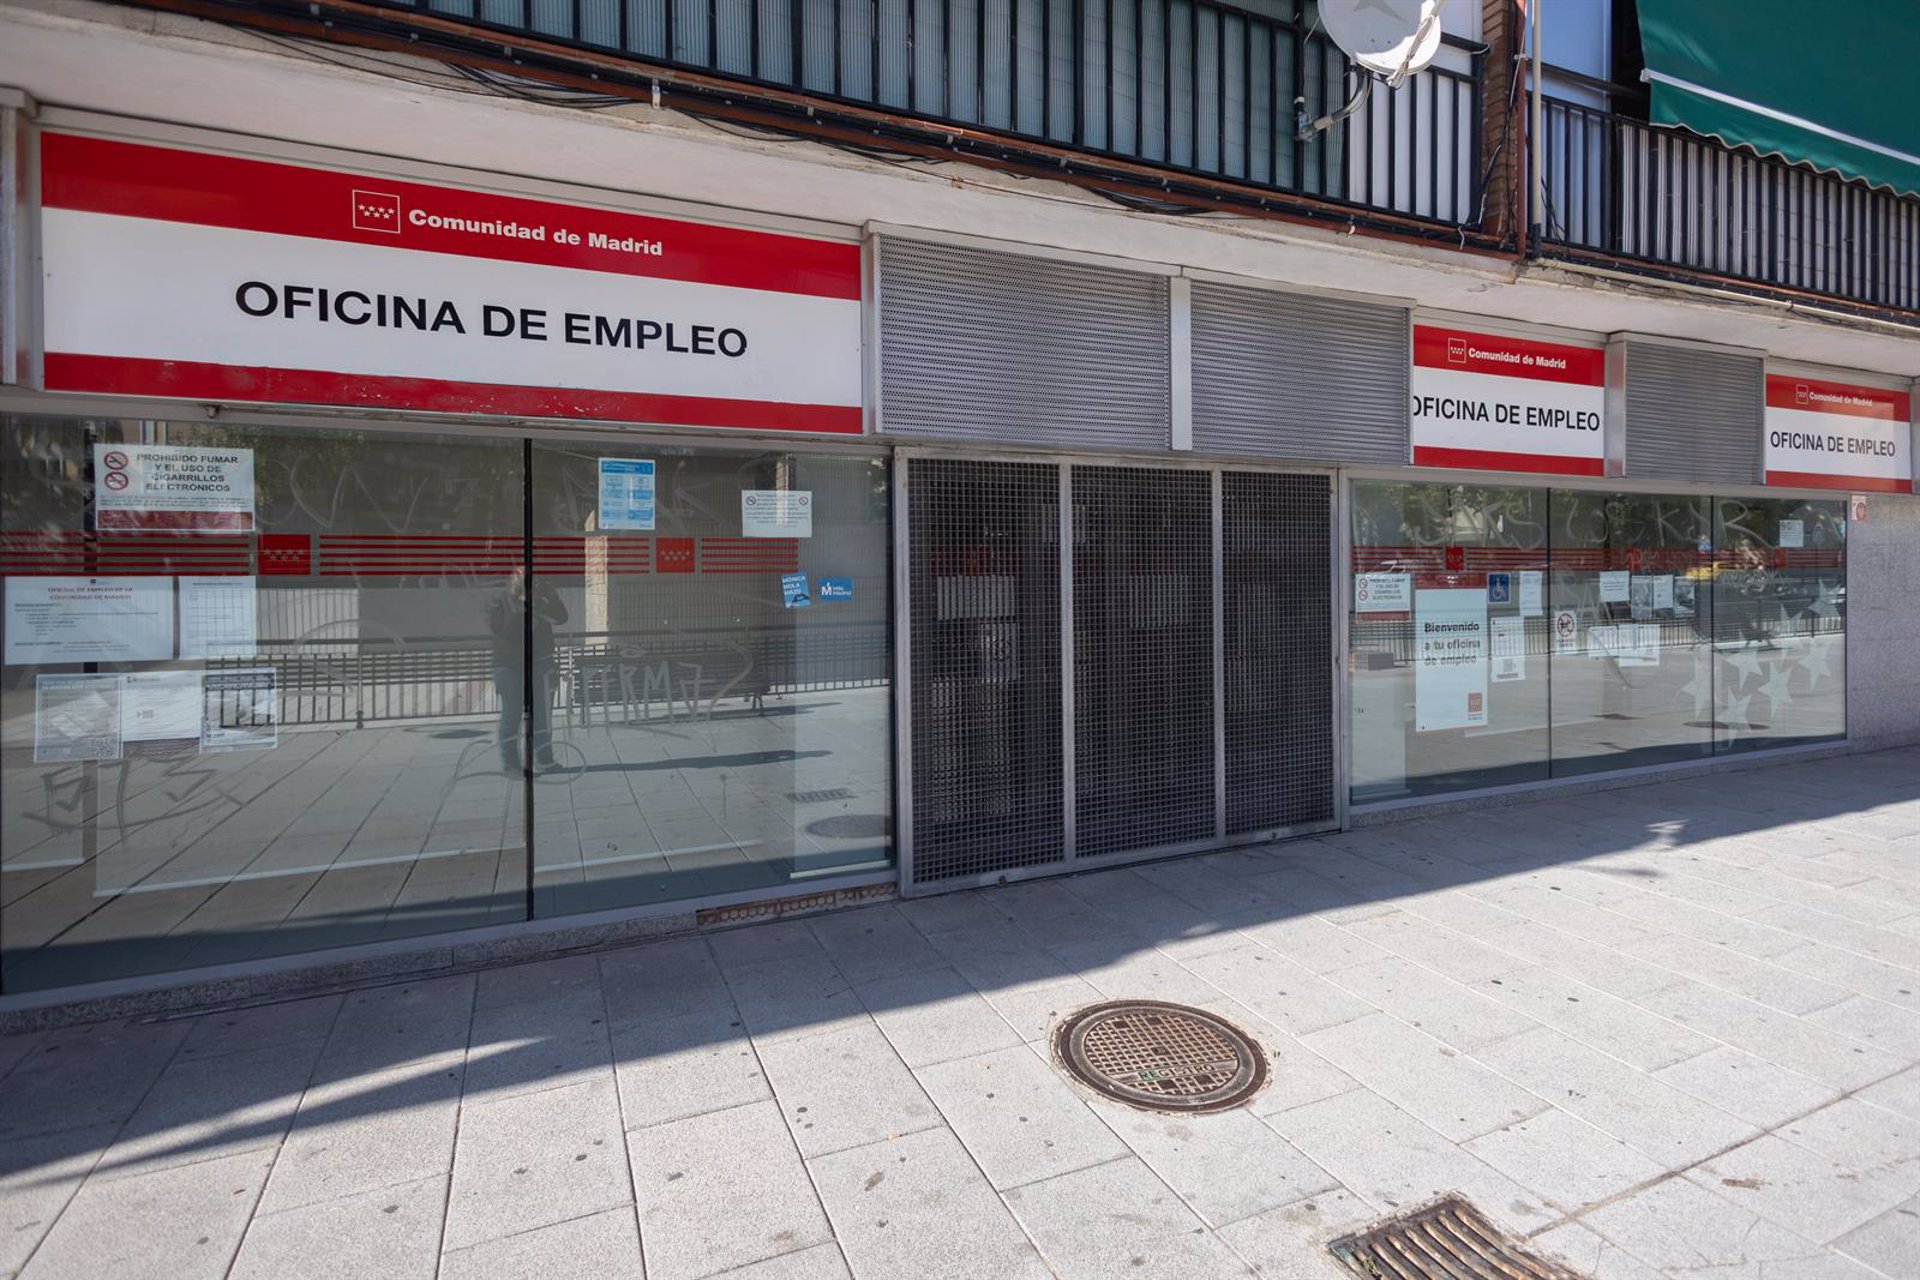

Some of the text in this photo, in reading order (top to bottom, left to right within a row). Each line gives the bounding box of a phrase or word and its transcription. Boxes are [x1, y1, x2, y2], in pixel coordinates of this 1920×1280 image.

[408, 208, 662, 256] Comunidad de Madrid
[235, 281, 748, 358] OFICINA DE EMPLEO
[1468, 347, 1566, 369] Comunidad de Madrid
[1809, 391, 1873, 407] Comunidad de Madrid
[1495, 403, 1520, 425] DE
[1526, 406, 1600, 432] EMPLEO
[1770, 431, 1896, 457] OFICINA DE EMPLEO
[136, 453, 239, 464] PROHIBIDO FUMAR
[181, 465, 204, 473] USO
[206, 465, 222, 473] DE
[1424, 621, 1480, 633] Bienvenido
[1434, 640, 1444, 650] tu
[1447, 638, 1481, 650] oficina
[1424, 654, 1477, 667] de empleo
